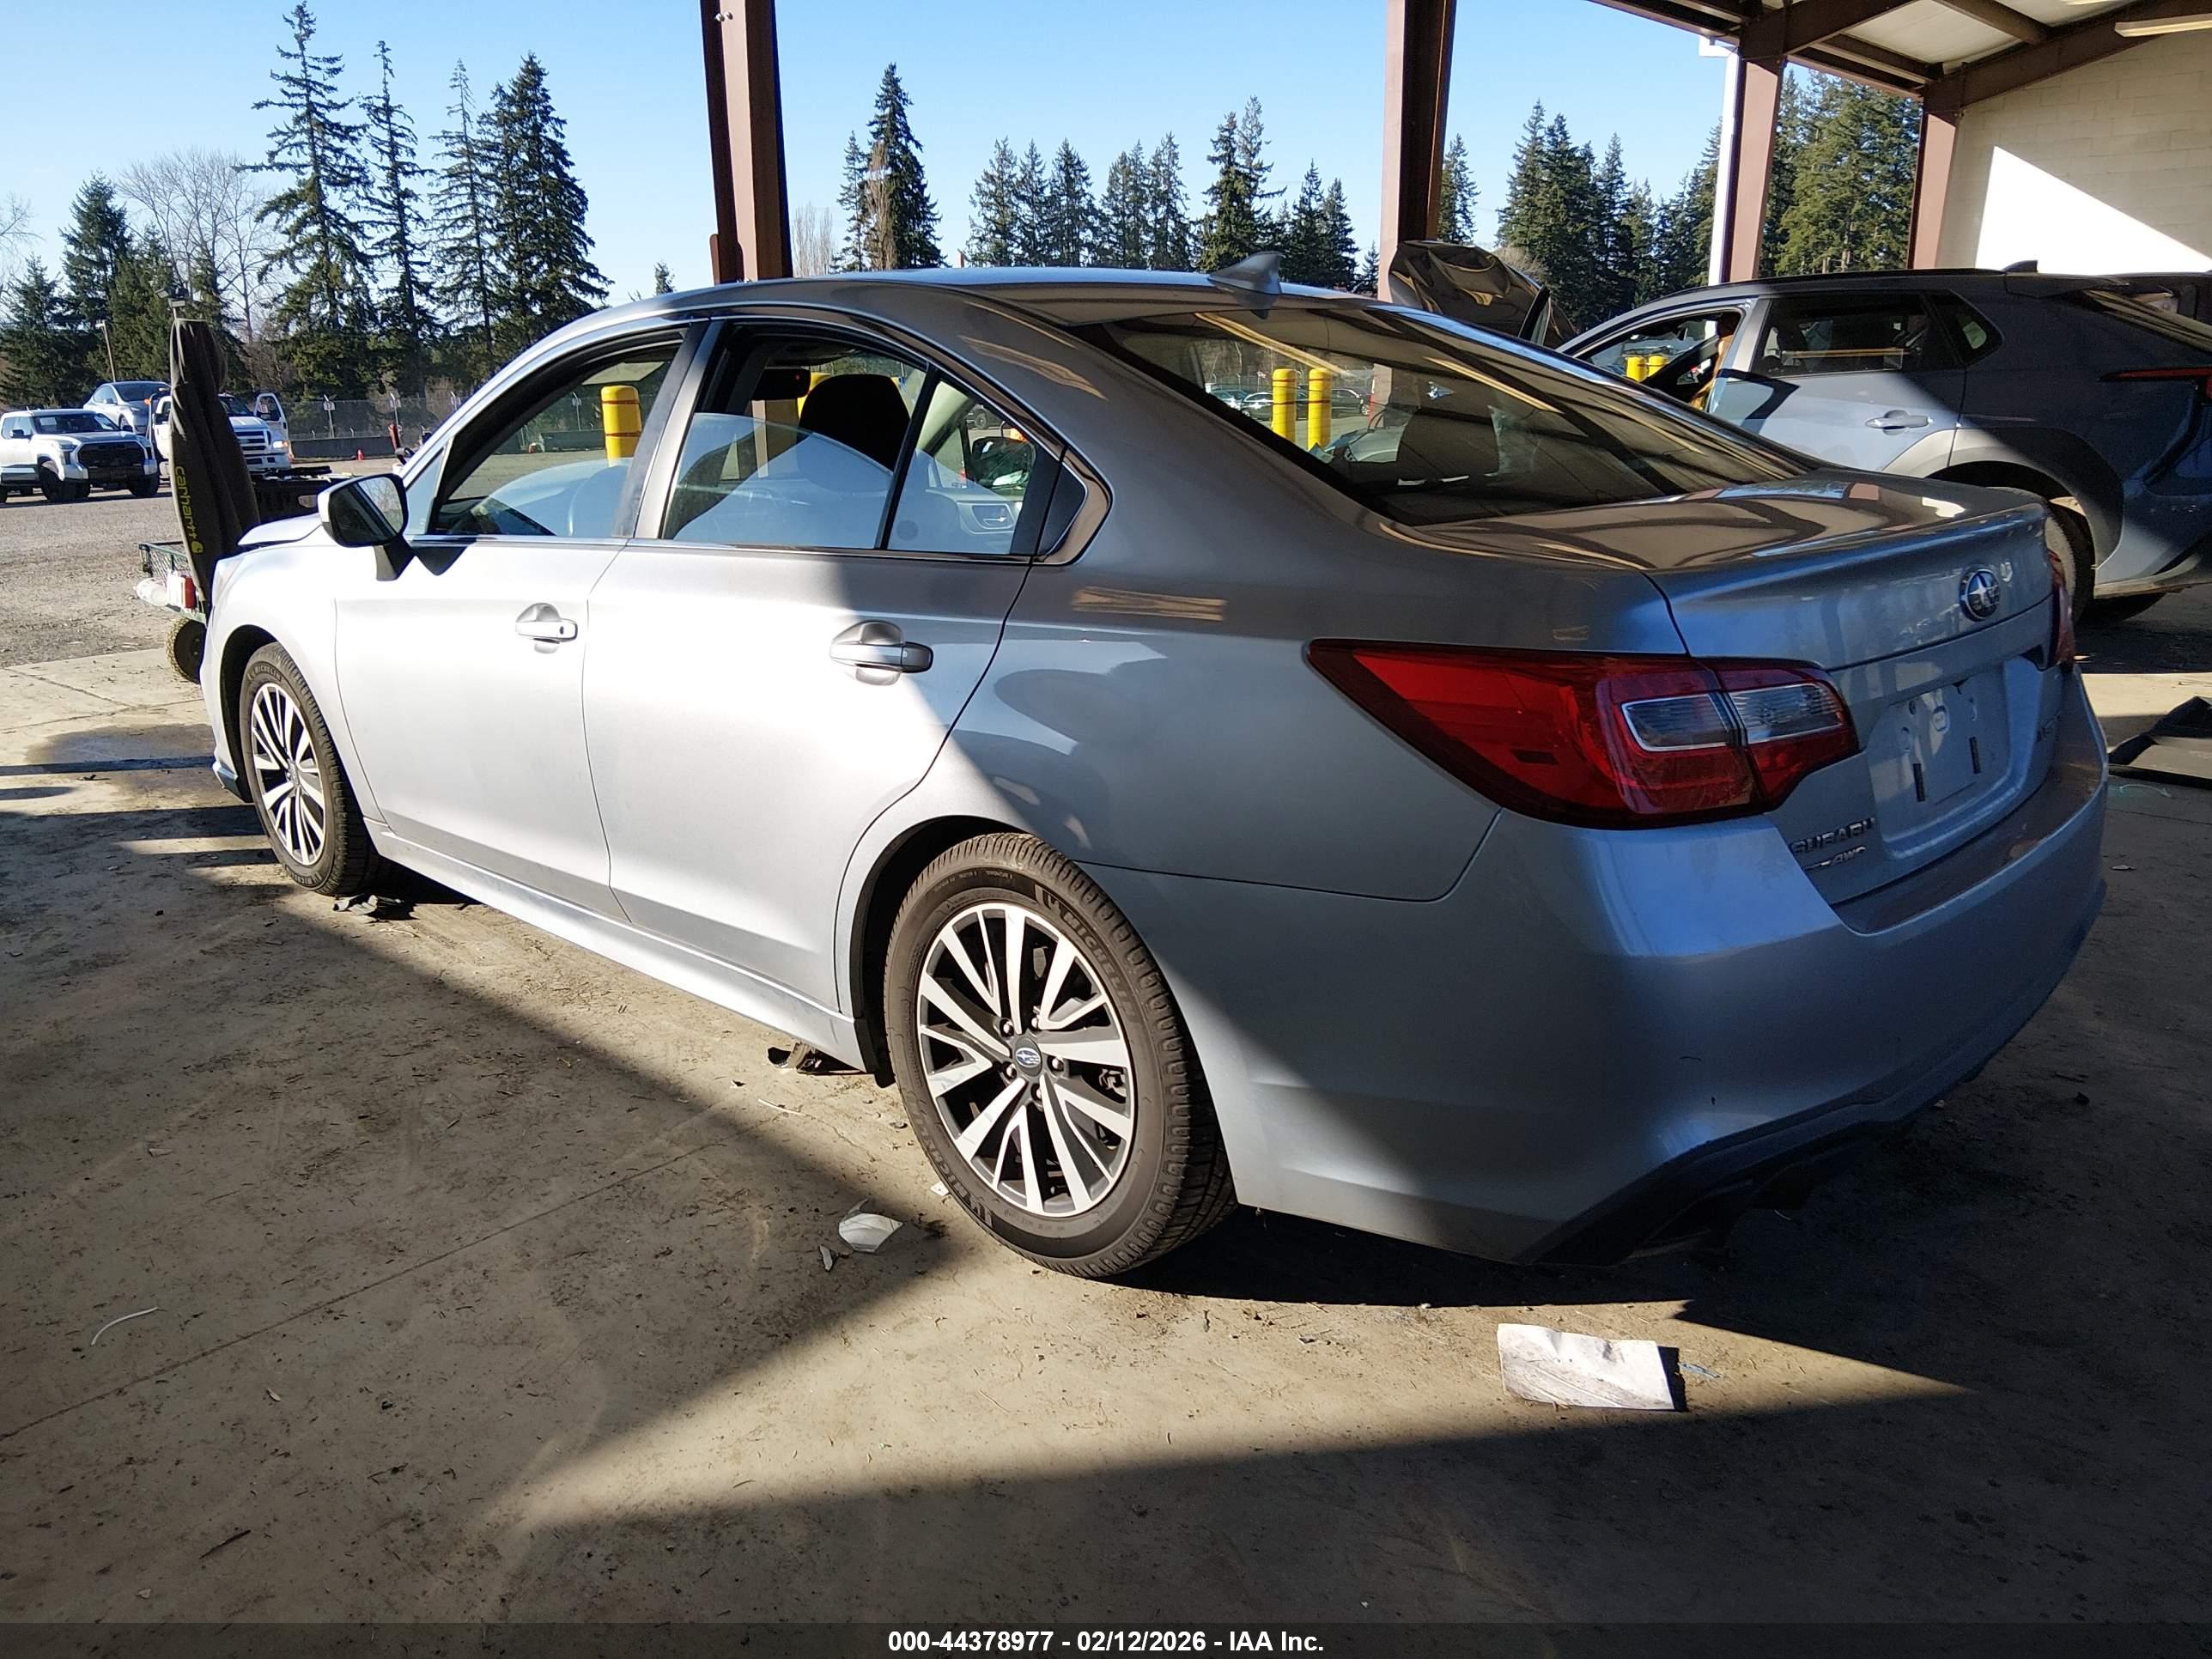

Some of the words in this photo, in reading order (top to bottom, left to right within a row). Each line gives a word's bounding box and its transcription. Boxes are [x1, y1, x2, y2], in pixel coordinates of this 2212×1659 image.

[175, 466, 198, 539] carhartt
[1790, 817, 1875, 854] SUBARU
[1063, 911, 1137, 1017] MICHELIN
